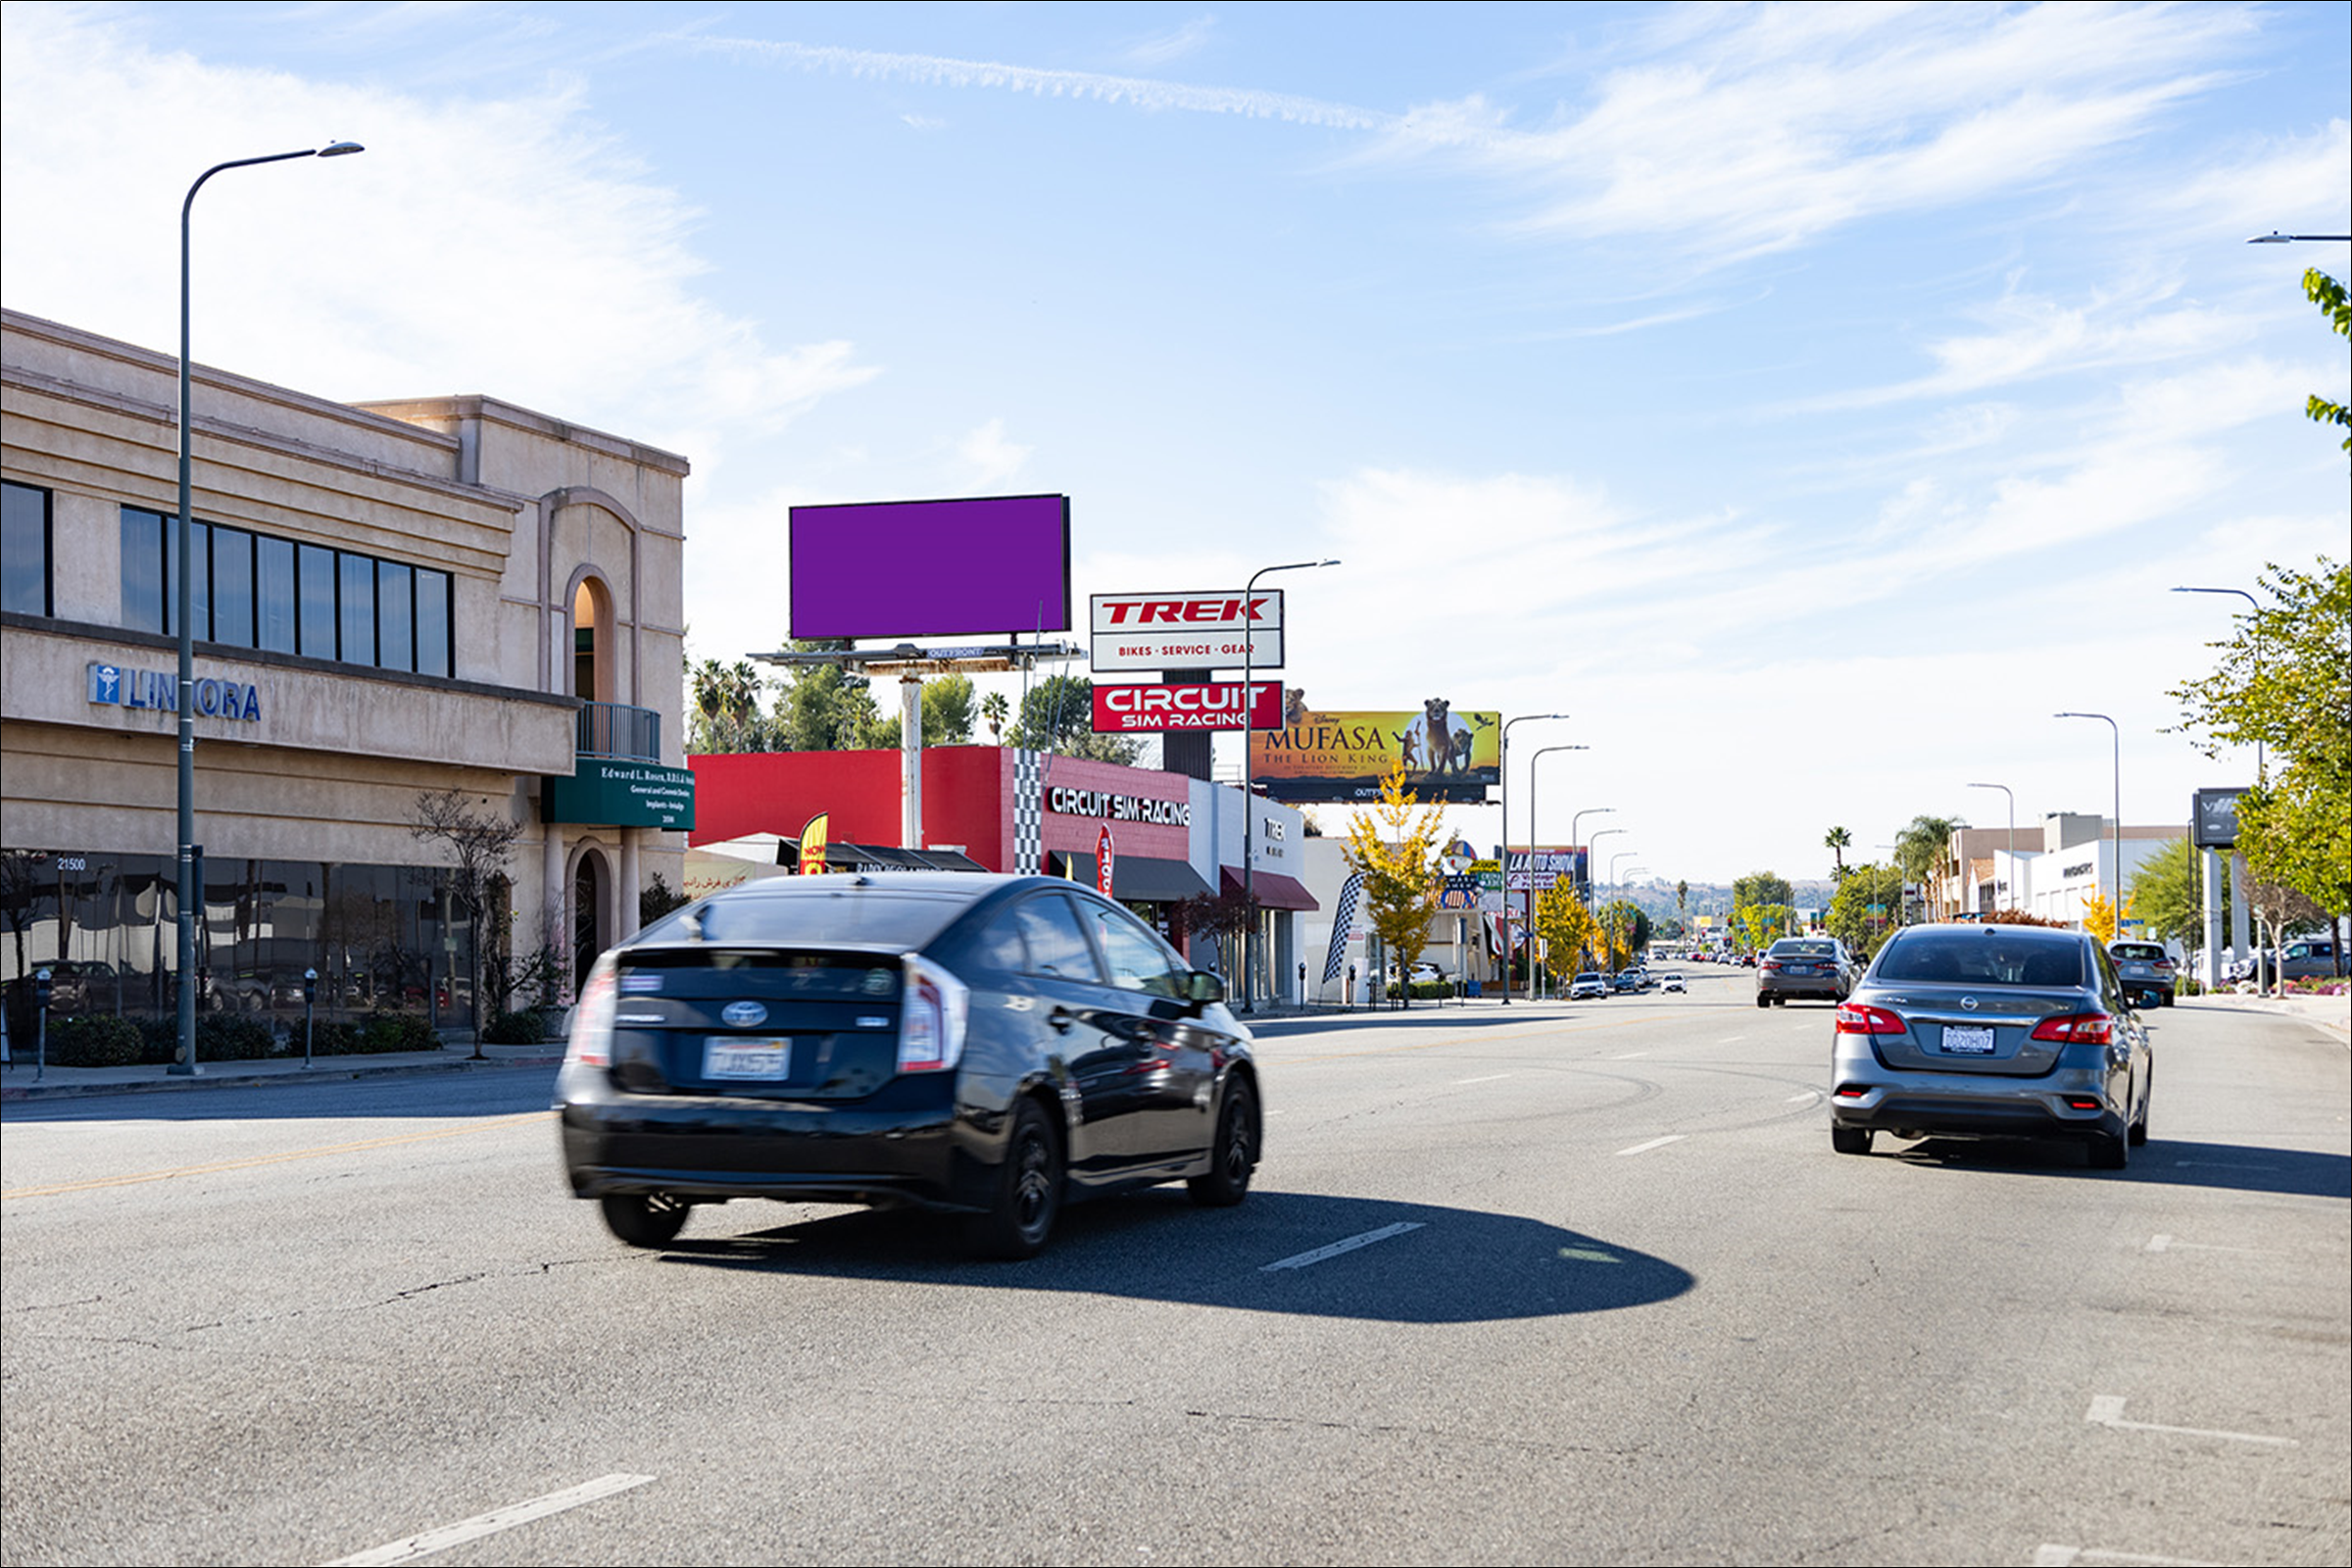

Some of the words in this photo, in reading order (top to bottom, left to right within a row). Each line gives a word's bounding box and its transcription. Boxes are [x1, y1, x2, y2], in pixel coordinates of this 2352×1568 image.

[1102, 598, 1270, 624] TREK
[928, 647, 982, 658] OUTFRONT
[1118, 646, 1152, 657] BIKES
[1161, 644, 1211, 656] SERVICE
[1221, 644, 1255, 655] GEAR
[122, 668, 262, 722] LINORA
[1104, 686, 1268, 711] CIRCUIT
[1121, 713, 1163, 727] SIM
[1168, 712, 1252, 727] RACING
[1313, 713, 1341, 725] Disney
[1264, 726, 1387, 750] MUFASA
[1263, 755, 1291, 763] THE
[1301, 754, 1339, 763] LION
[1347, 754, 1388, 763] KING
[601, 767, 635, 780] Edward
[1052, 787, 1110, 817] CIRCUIT
[1113, 796, 1141, 821] SIM
[1143, 800, 1191, 826] RACING
[804, 845, 825, 857] NOW
[58, 858, 86, 870] 21500
[1509, 854, 1523, 871] LA
